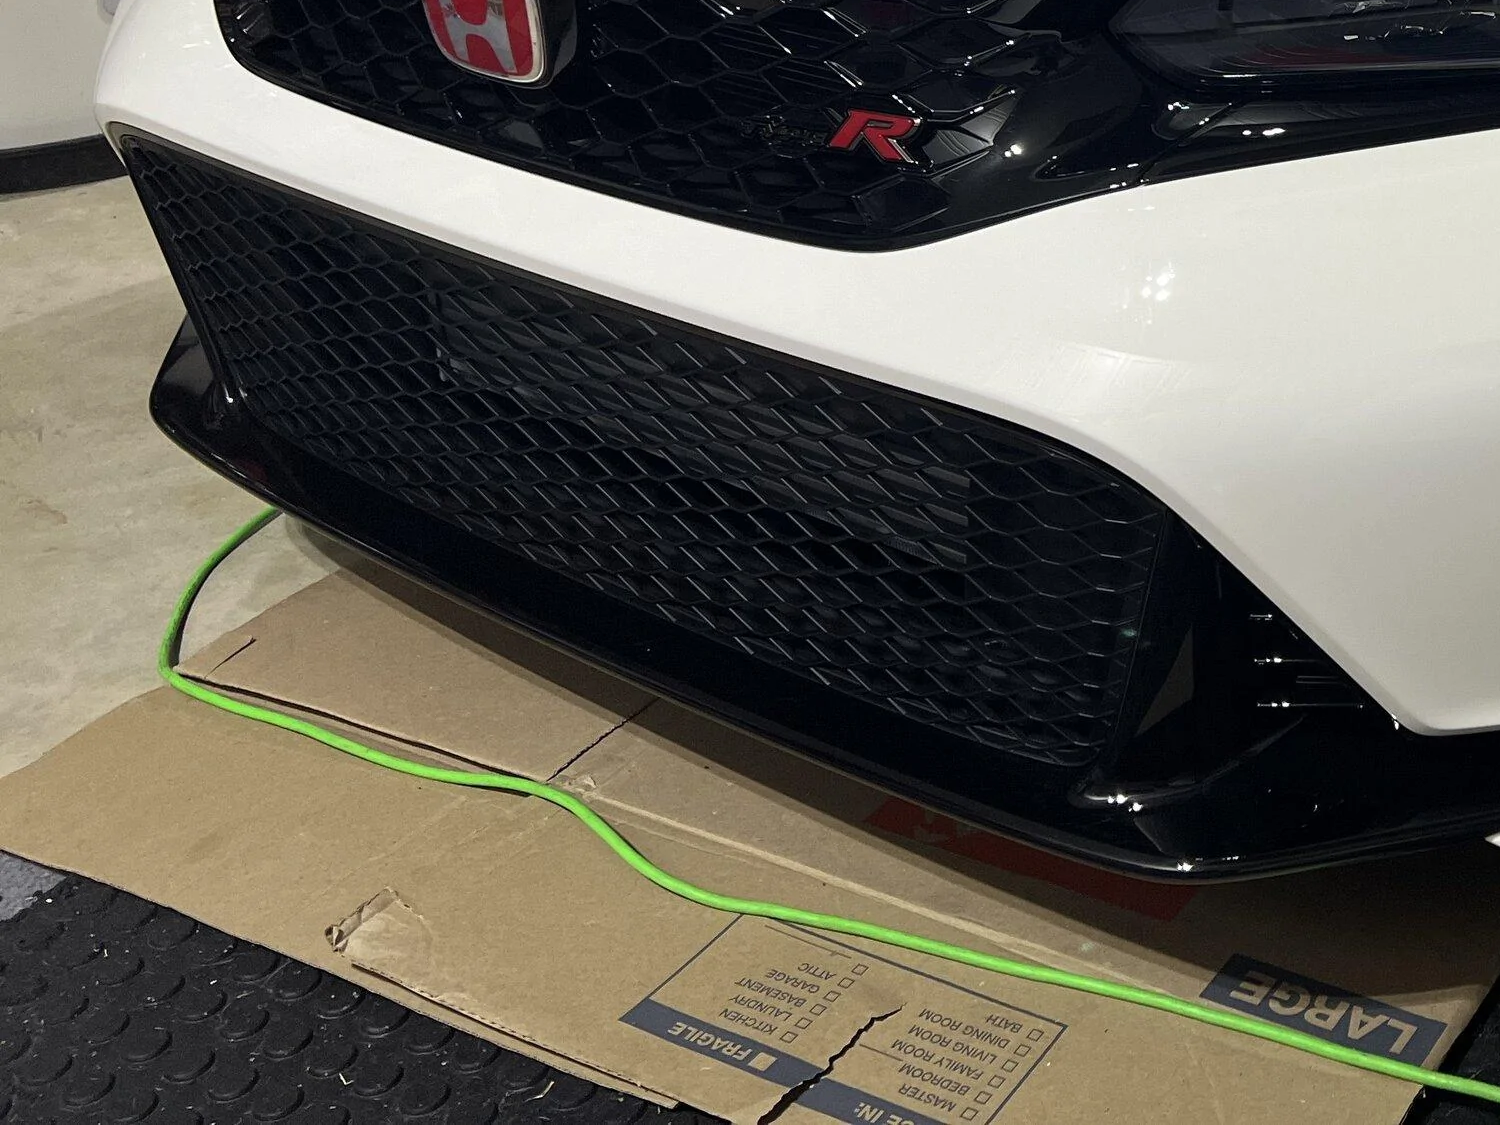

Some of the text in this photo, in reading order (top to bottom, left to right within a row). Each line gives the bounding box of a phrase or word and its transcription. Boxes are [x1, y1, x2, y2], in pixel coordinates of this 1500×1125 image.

[826, 107, 922, 164] R
[764, 968, 821, 994] GARAGE
[797, 962, 838, 981] ATTIC
[728, 993, 793, 1022] LAUNDRY
[734, 977, 808, 1008] BASEMENT
[718, 1008, 779, 1036] KITCHEN
[918, 1007, 1012, 1050] DINING ROOM
[984, 1013, 1023, 1034] BATH
[1229, 970, 1418, 1055] LARGE
[667, 1021, 753, 1062] FRAGILE
[907, 1024, 998, 1065] LIVING ROOM
[890, 1038, 984, 1081] FAMILY ROOM
[897, 1062, 971, 1096] BEDROOM
[898, 1082, 957, 1113] MASTER
